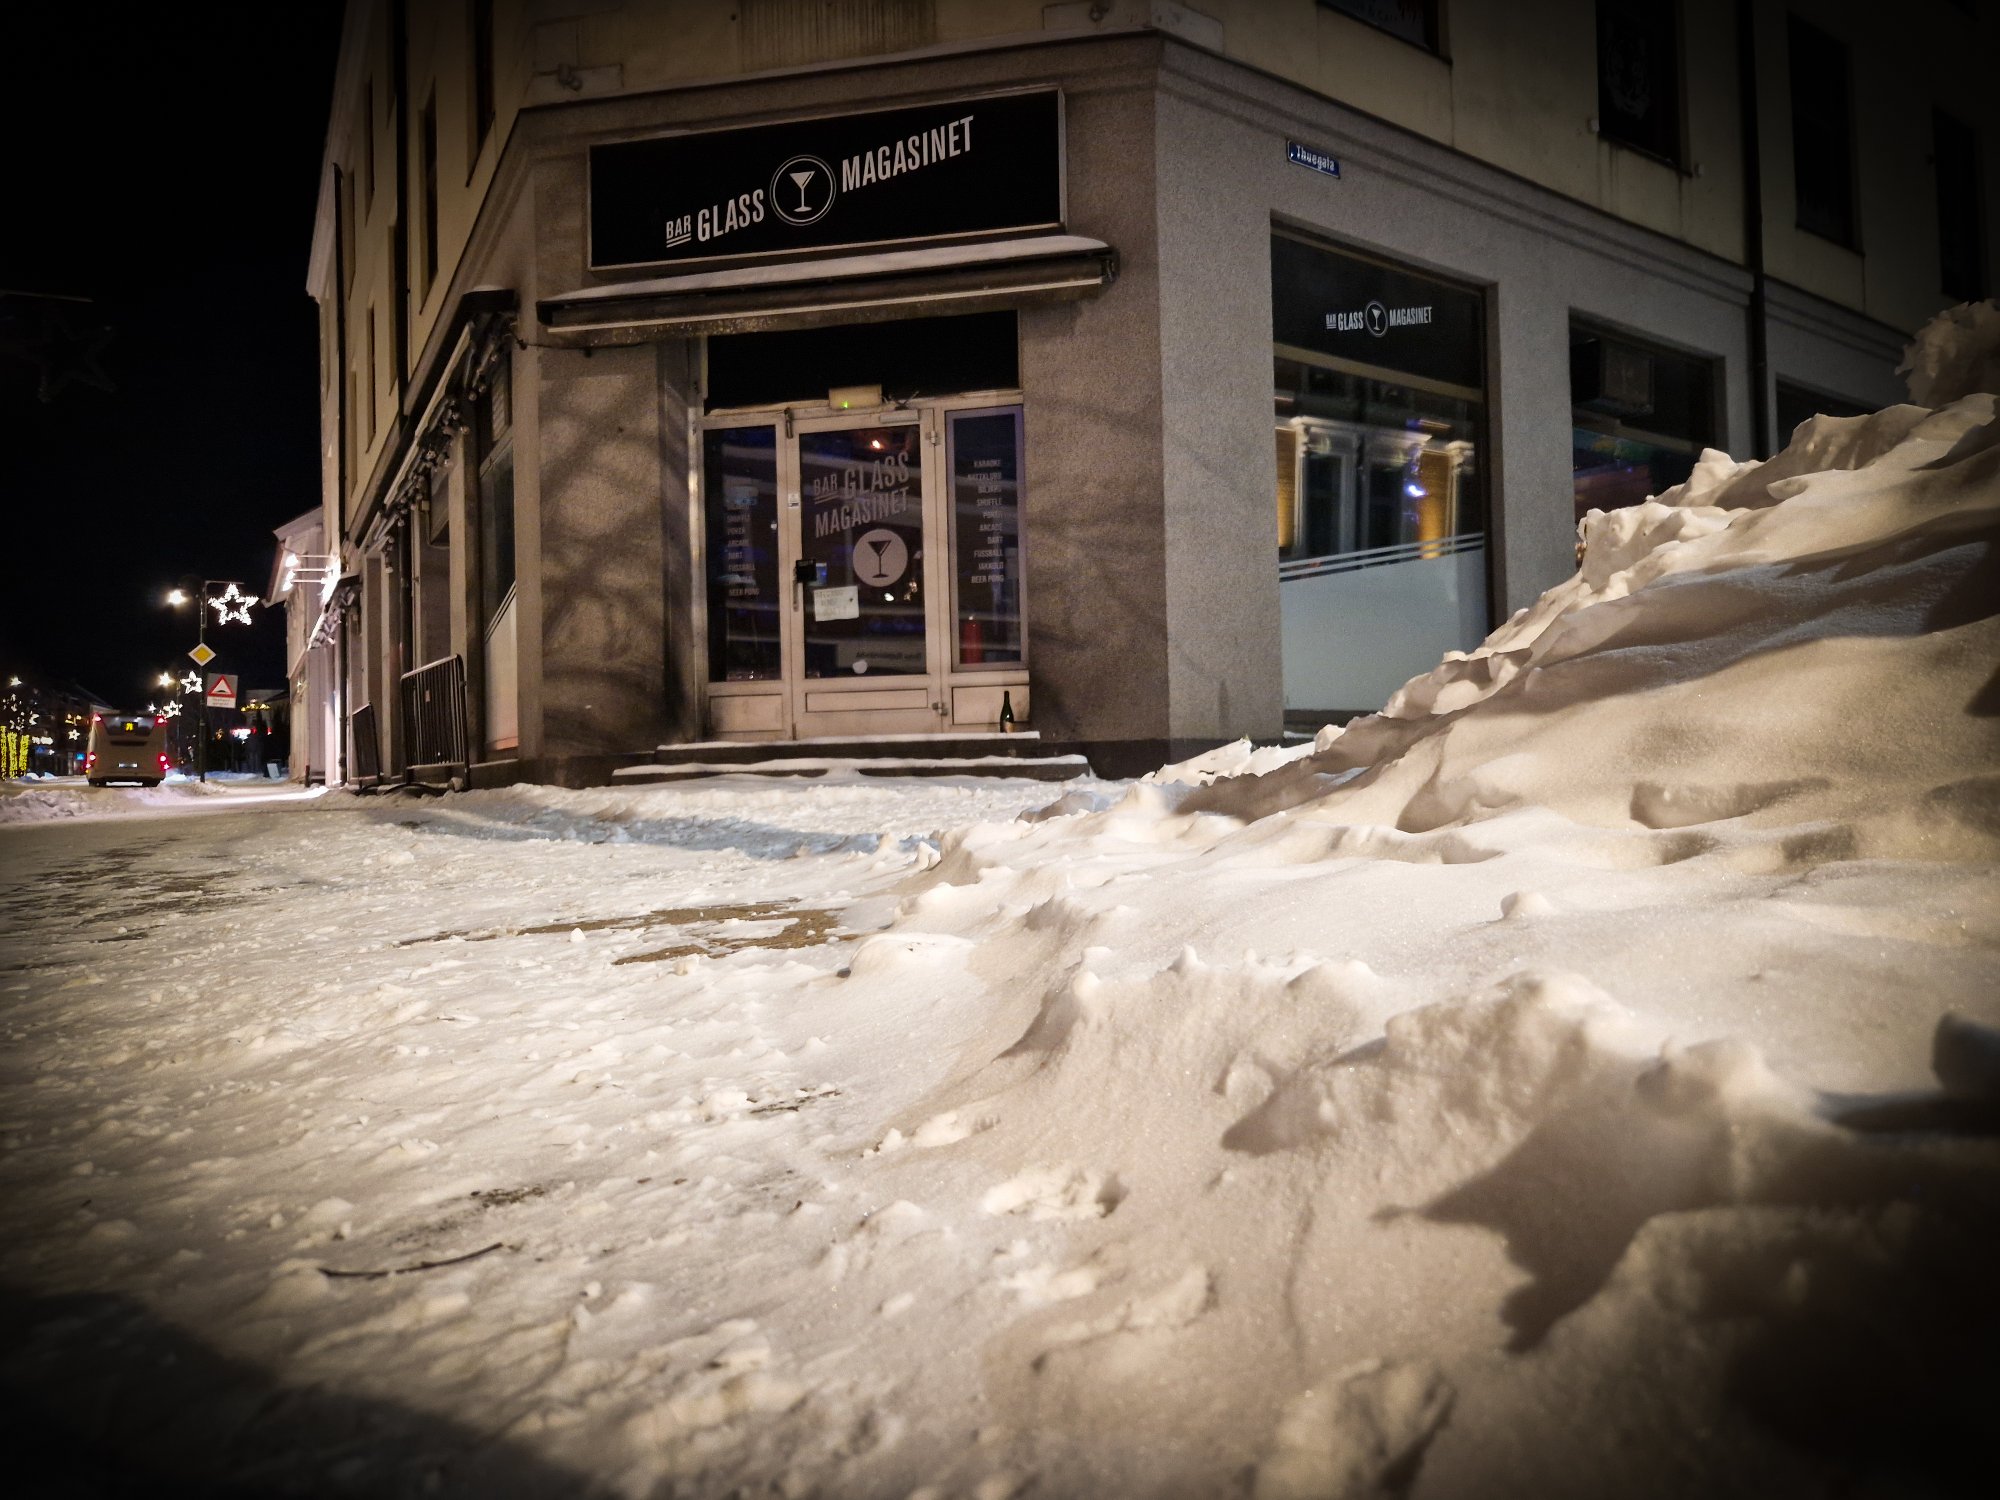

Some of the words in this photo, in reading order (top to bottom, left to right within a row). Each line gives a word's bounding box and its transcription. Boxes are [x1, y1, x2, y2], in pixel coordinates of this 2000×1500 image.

[665, 214, 692, 242] BAR
[697, 188, 765, 243] GLASS
[842, 115, 974, 194] MAGASINET
[1325, 313, 1337, 325] BAR
[1337, 311, 1364, 331] GLASS
[1389, 306, 1433, 327] MAGASINET
[813, 473, 838, 496] BAR
[844, 451, 910, 500] GLASS
[815, 486, 910, 539] MAGASINET
